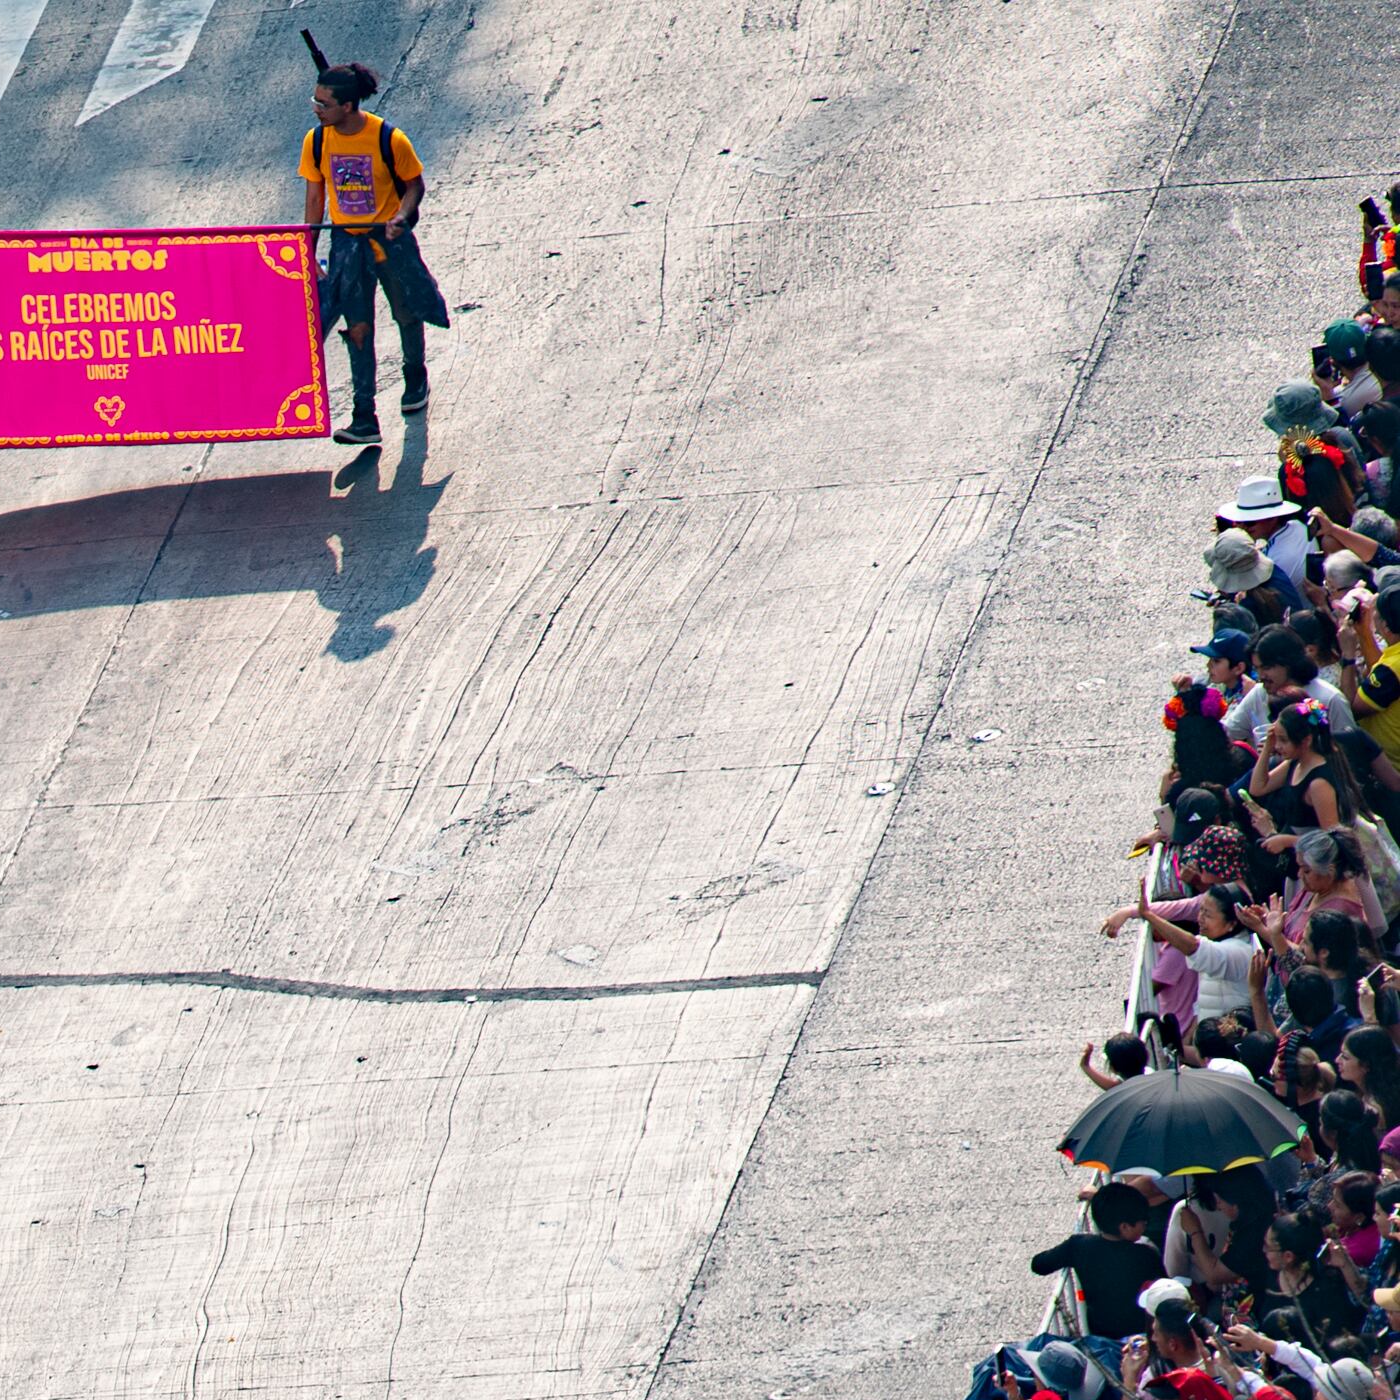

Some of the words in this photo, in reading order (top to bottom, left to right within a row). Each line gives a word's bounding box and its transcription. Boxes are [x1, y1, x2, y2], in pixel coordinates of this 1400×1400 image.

[69, 236, 99, 249] DÍA
[102, 237, 124, 249] DE
[28, 249, 168, 273] MUERTOS
[20, 290, 177, 325] CELEBREMOS
[10, 324, 94, 361] RAÍCES
[100, 329, 131, 359] DE
[136, 327, 168, 357] LA
[173, 318, 244, 354] NIÑEZ
[86, 364, 129, 380] UNICEF
[105, 433, 121, 442] DE
